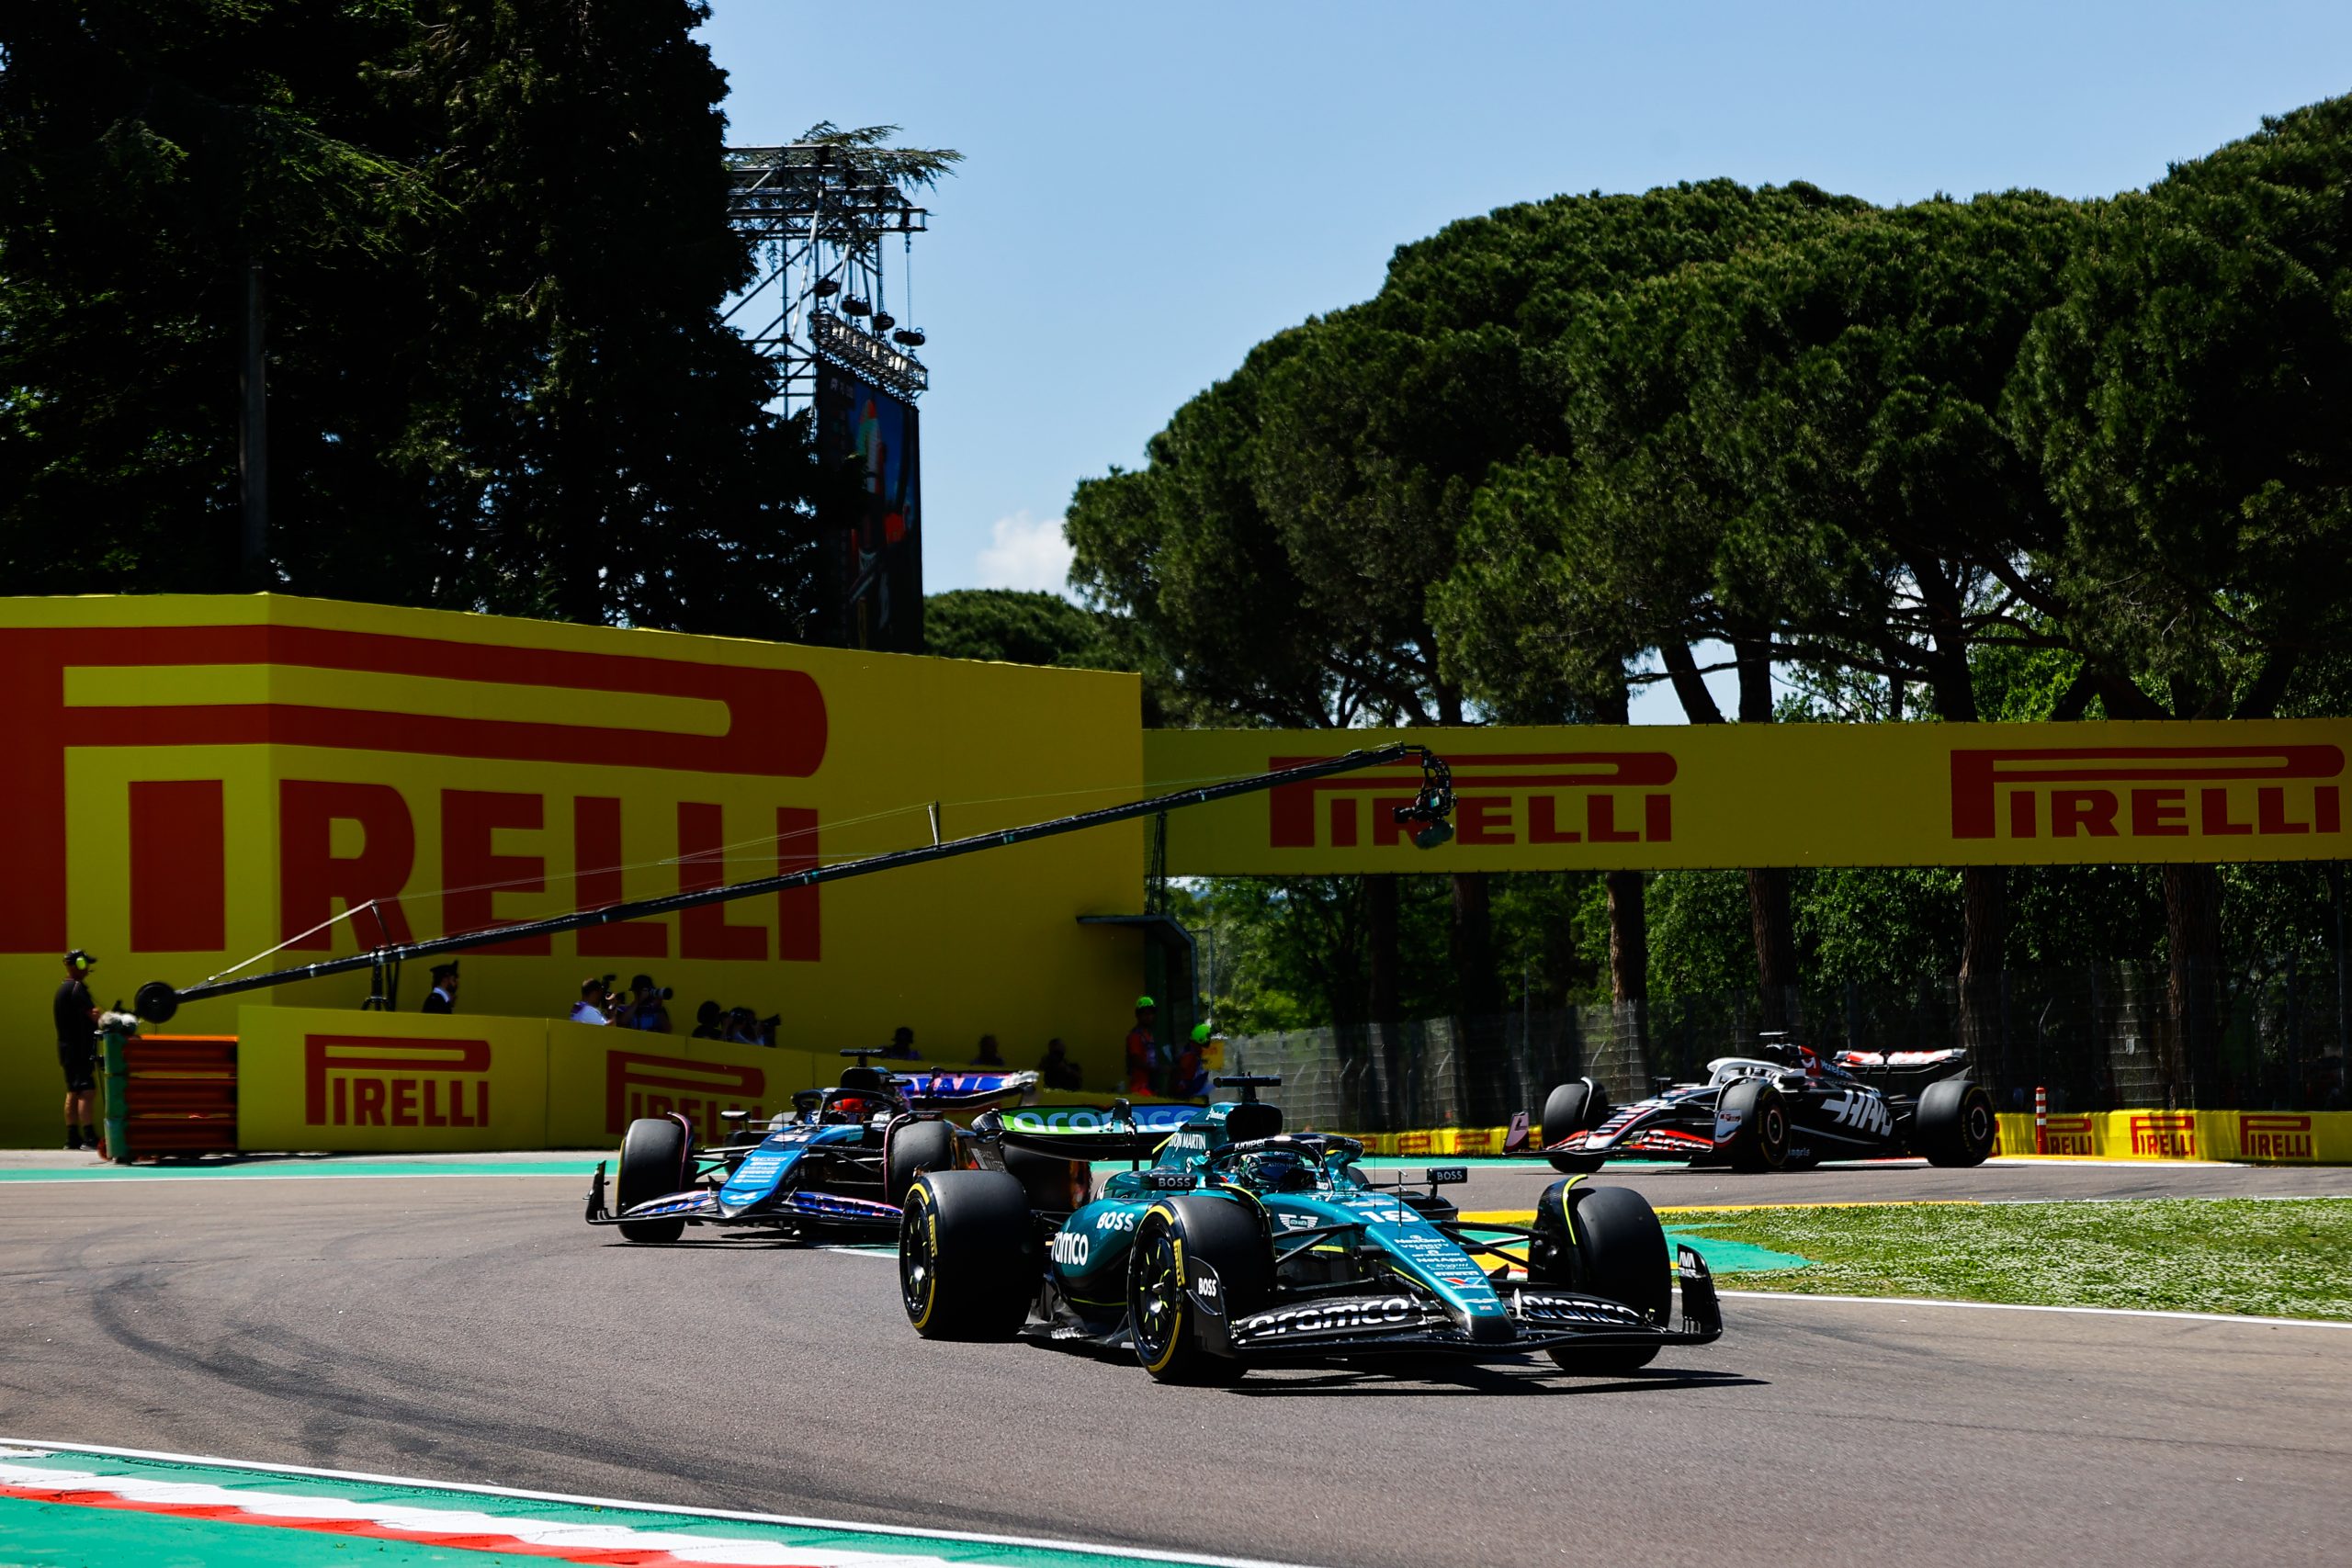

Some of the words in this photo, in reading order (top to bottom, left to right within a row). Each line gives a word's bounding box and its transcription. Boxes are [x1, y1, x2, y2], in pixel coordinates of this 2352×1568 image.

[0, 625, 829, 962] PIRELLI
[1269, 752, 1678, 848] PIRELLI
[1951, 745, 2345, 839] PIRELLI
[305, 1034, 492, 1127] PIRELLI
[2040, 1118, 2093, 1155] PRELLI
[2131, 1116, 2195, 1156] PIRELLI
[2240, 1116, 2312, 1157] PIRELLI
[1158, 1178, 1191, 1188] BOSS
[1437, 1170, 1463, 1181] BOSS
[1096, 1211, 1135, 1232] BOSS
[1359, 1210, 1419, 1224] 18
[1050, 1232, 1089, 1266] ramco
[1198, 1277, 1217, 1297] BOSS
[1249, 1298, 1409, 1336] aramco
